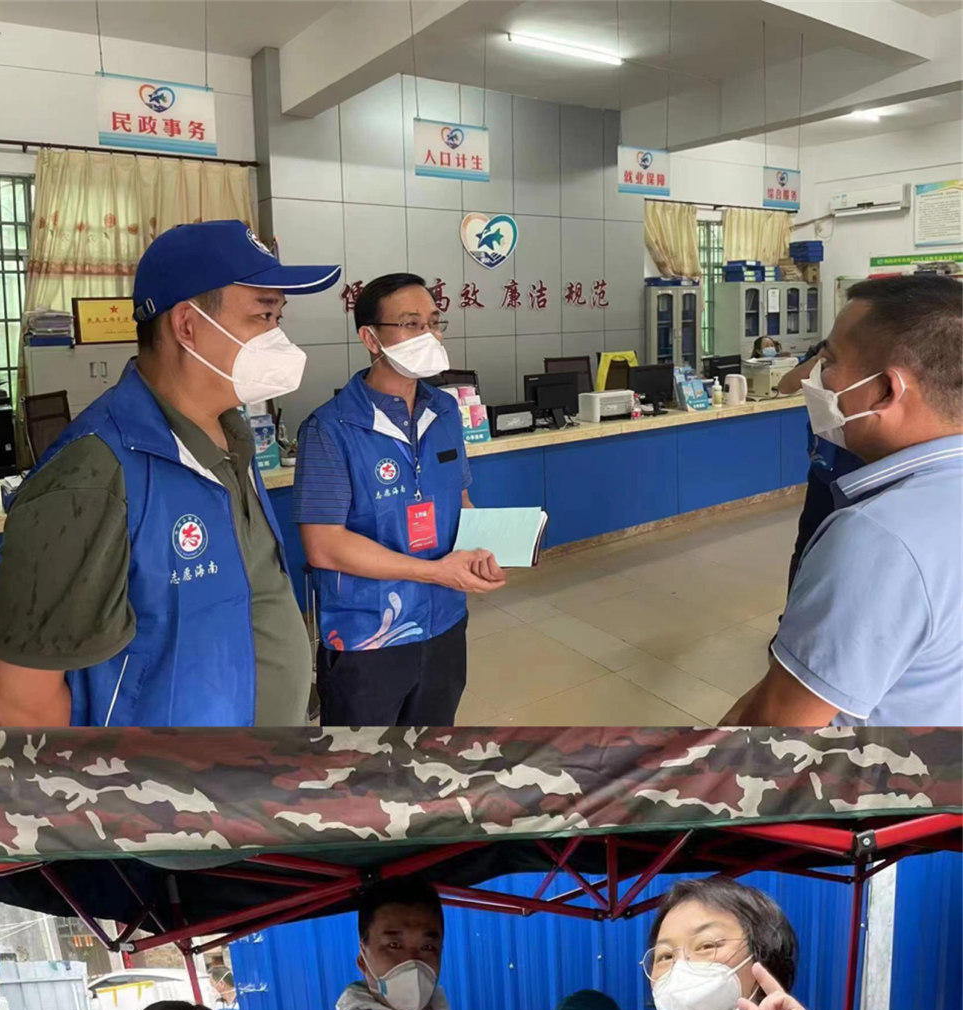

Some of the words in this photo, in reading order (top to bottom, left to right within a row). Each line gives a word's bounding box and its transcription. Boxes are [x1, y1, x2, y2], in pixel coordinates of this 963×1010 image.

[111, 111, 206, 141] 民政事务
[424, 149, 483, 171] 人口计生
[623, 169, 666, 187] 就业保障
[767, 187, 798, 202] 综合服务
[429, 278, 485, 313] 高效
[501, 279, 549, 310] 廉洁
[564, 279, 610, 308] 规范
[169, 560, 219, 585] 志愿海南
